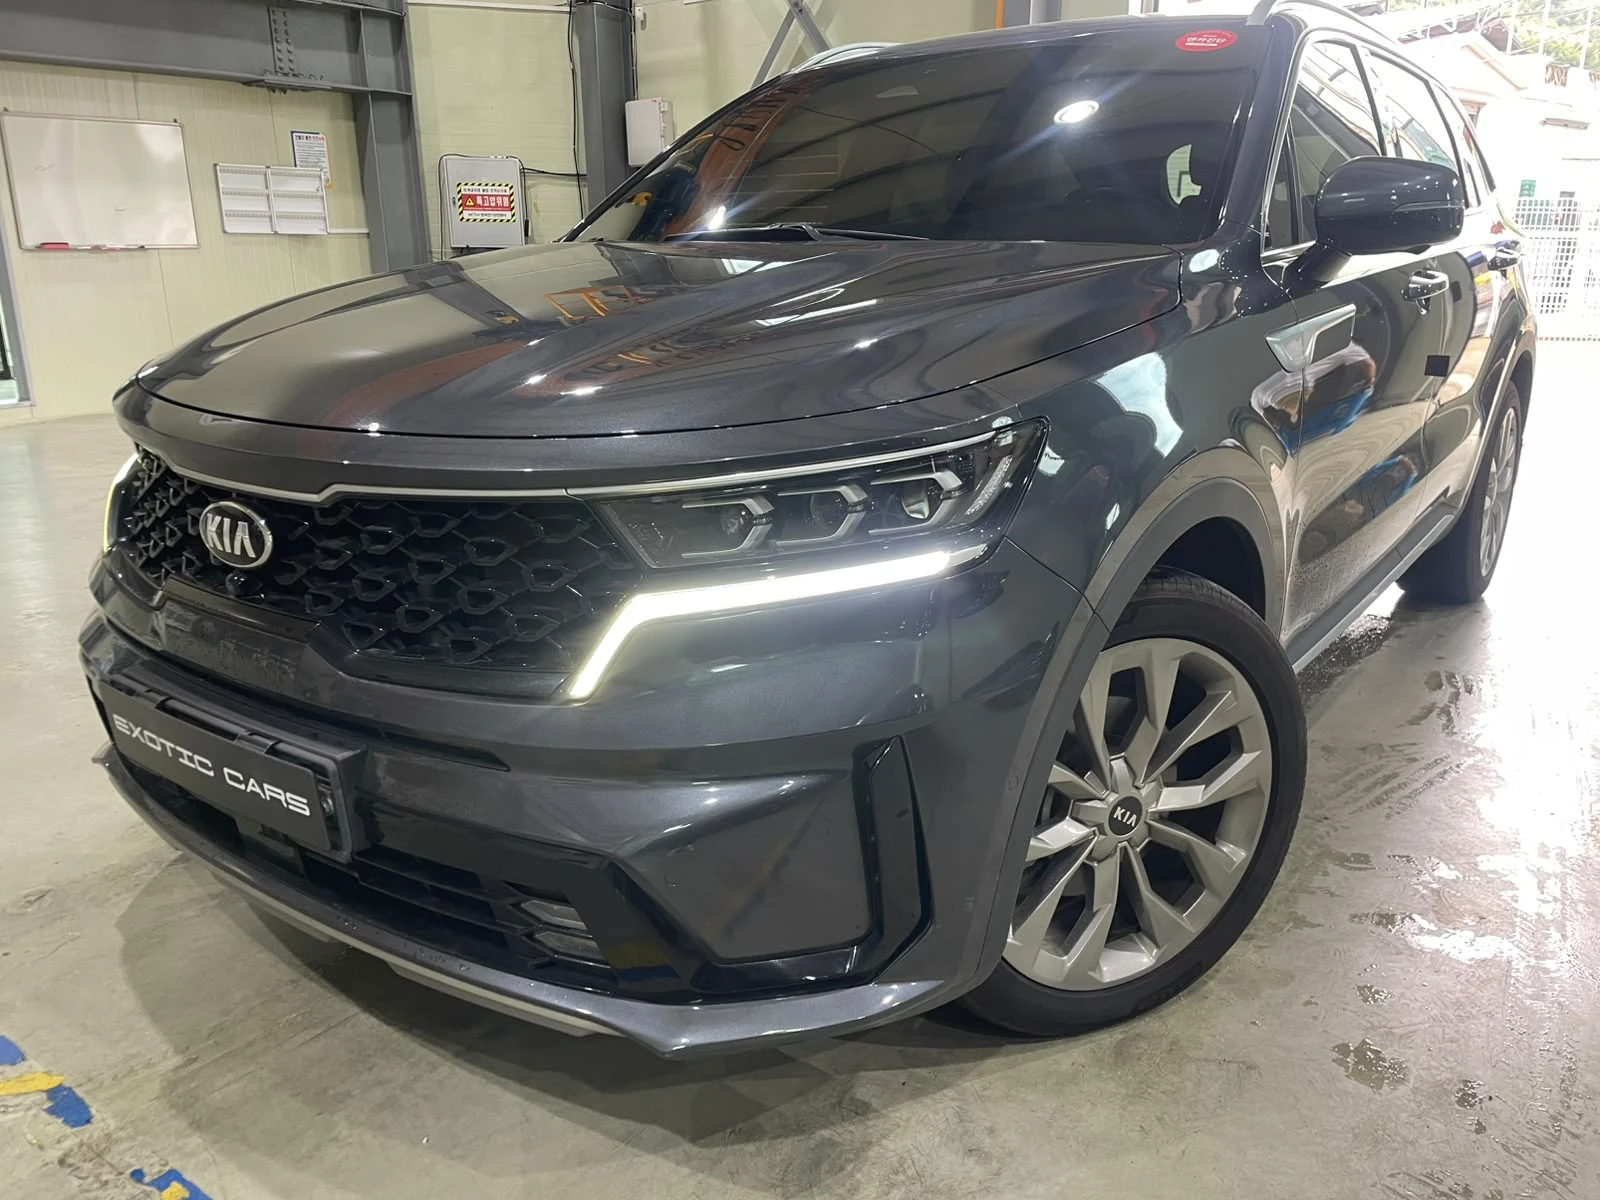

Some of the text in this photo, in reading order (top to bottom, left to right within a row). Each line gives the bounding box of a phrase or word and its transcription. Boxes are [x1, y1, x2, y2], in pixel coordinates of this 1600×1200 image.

[476, 195, 509, 207] 특고압위험
[206, 512, 257, 558] KIA
[112, 713, 311, 817] EXOTIC CARS
[1113, 806, 1137, 827] KIA
